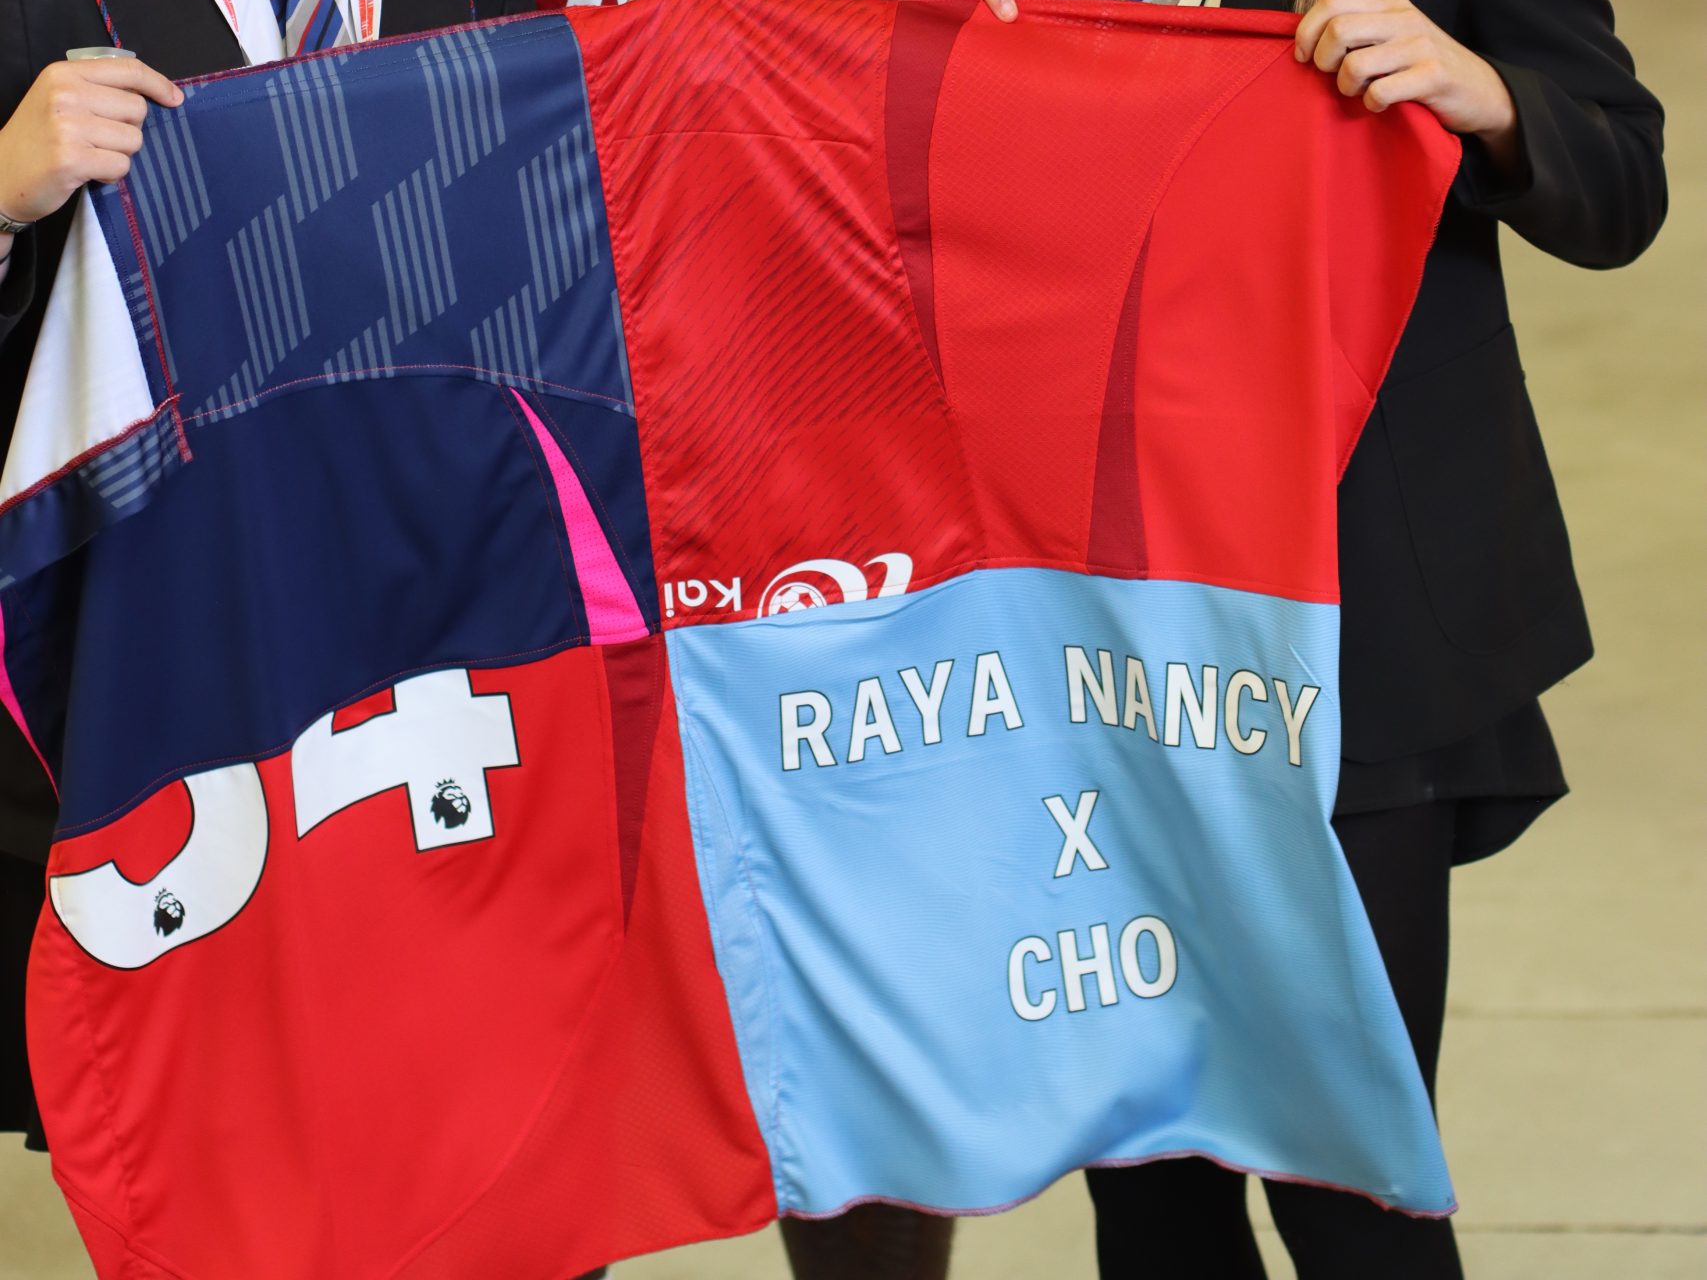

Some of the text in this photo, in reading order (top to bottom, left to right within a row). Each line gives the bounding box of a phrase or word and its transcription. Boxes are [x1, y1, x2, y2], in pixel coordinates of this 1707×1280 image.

[778, 645, 1321, 772] RAYA NANCY
[1041, 790, 1109, 879] X
[1007, 915, 1178, 1021] CHO
